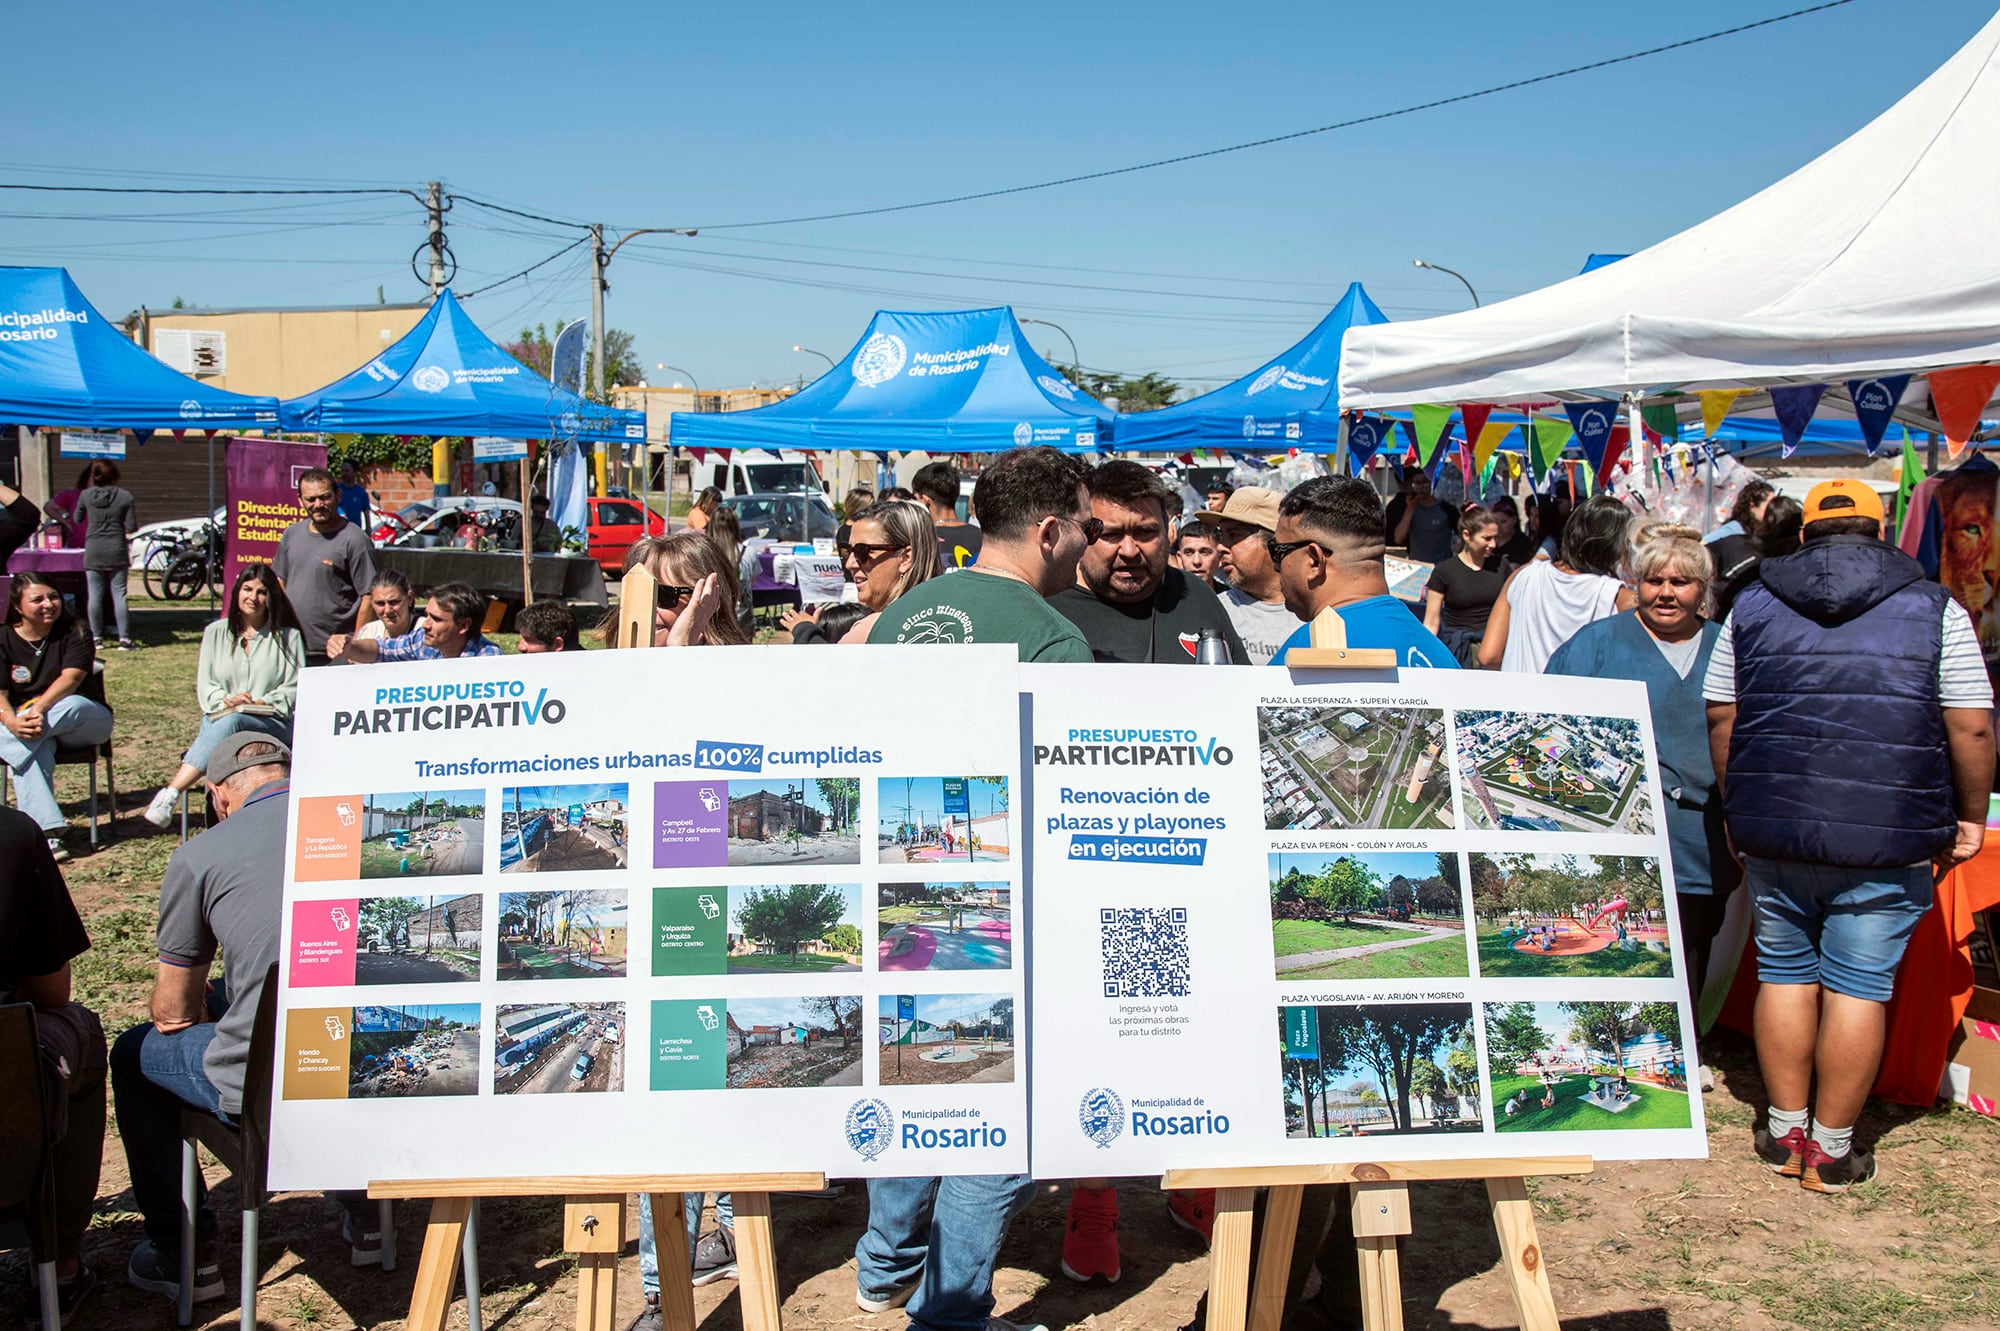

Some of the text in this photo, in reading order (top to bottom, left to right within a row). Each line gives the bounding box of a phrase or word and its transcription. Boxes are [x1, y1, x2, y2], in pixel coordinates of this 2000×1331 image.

[913, 343, 1010, 364] Municipalidad
[908, 360, 979, 376] de Rosario
[237, 500, 298, 516] Dirección
[375, 680, 525, 705] PRESUPUESTO
[1260, 697, 1288, 705] PLAZA
[1302, 697, 1353, 705] ESPERANZA
[333, 688, 567, 736] PARTICIPATIVO
[1068, 729, 1198, 743] PRESUPUESTO
[1034, 737, 1234, 766] PARTICIPATIVO
[415, 746, 883, 777] Transformaciones urbanas 100% cumplidas
[1060, 787, 1211, 804] Renovación de
[662, 819, 694, 828] Campbell
[1047, 813, 1226, 834] plazas y playones
[662, 828, 667, 836] y
[1069, 838, 1201, 861] en ejecución
[1319, 840, 1349, 849] PERÓN
[1357, 839, 1387, 849] COLÓN
[661, 932, 691, 941] y Urquiza
[299, 940, 322, 948] Buenos
[1310, 993, 1366, 1002] YUGOSLAVIA
[1388, 991, 1418, 1000] ARIJÓN
[1153, 1006, 1158, 1014] y
[1160, 1004, 1179, 1013] votá
[1109, 1014, 1190, 1026] las próximas obras
[1118, 1026, 1182, 1038] para tu distrito
[660, 1037, 693, 1045] Larrechea
[660, 1047, 665, 1055] y
[1132, 1097, 1204, 1109] Municipalidad de
[902, 1108, 981, 1120] Municipalidad de
[1132, 1109, 1230, 1136] Rosario
[902, 1122, 1007, 1149] Rosario
